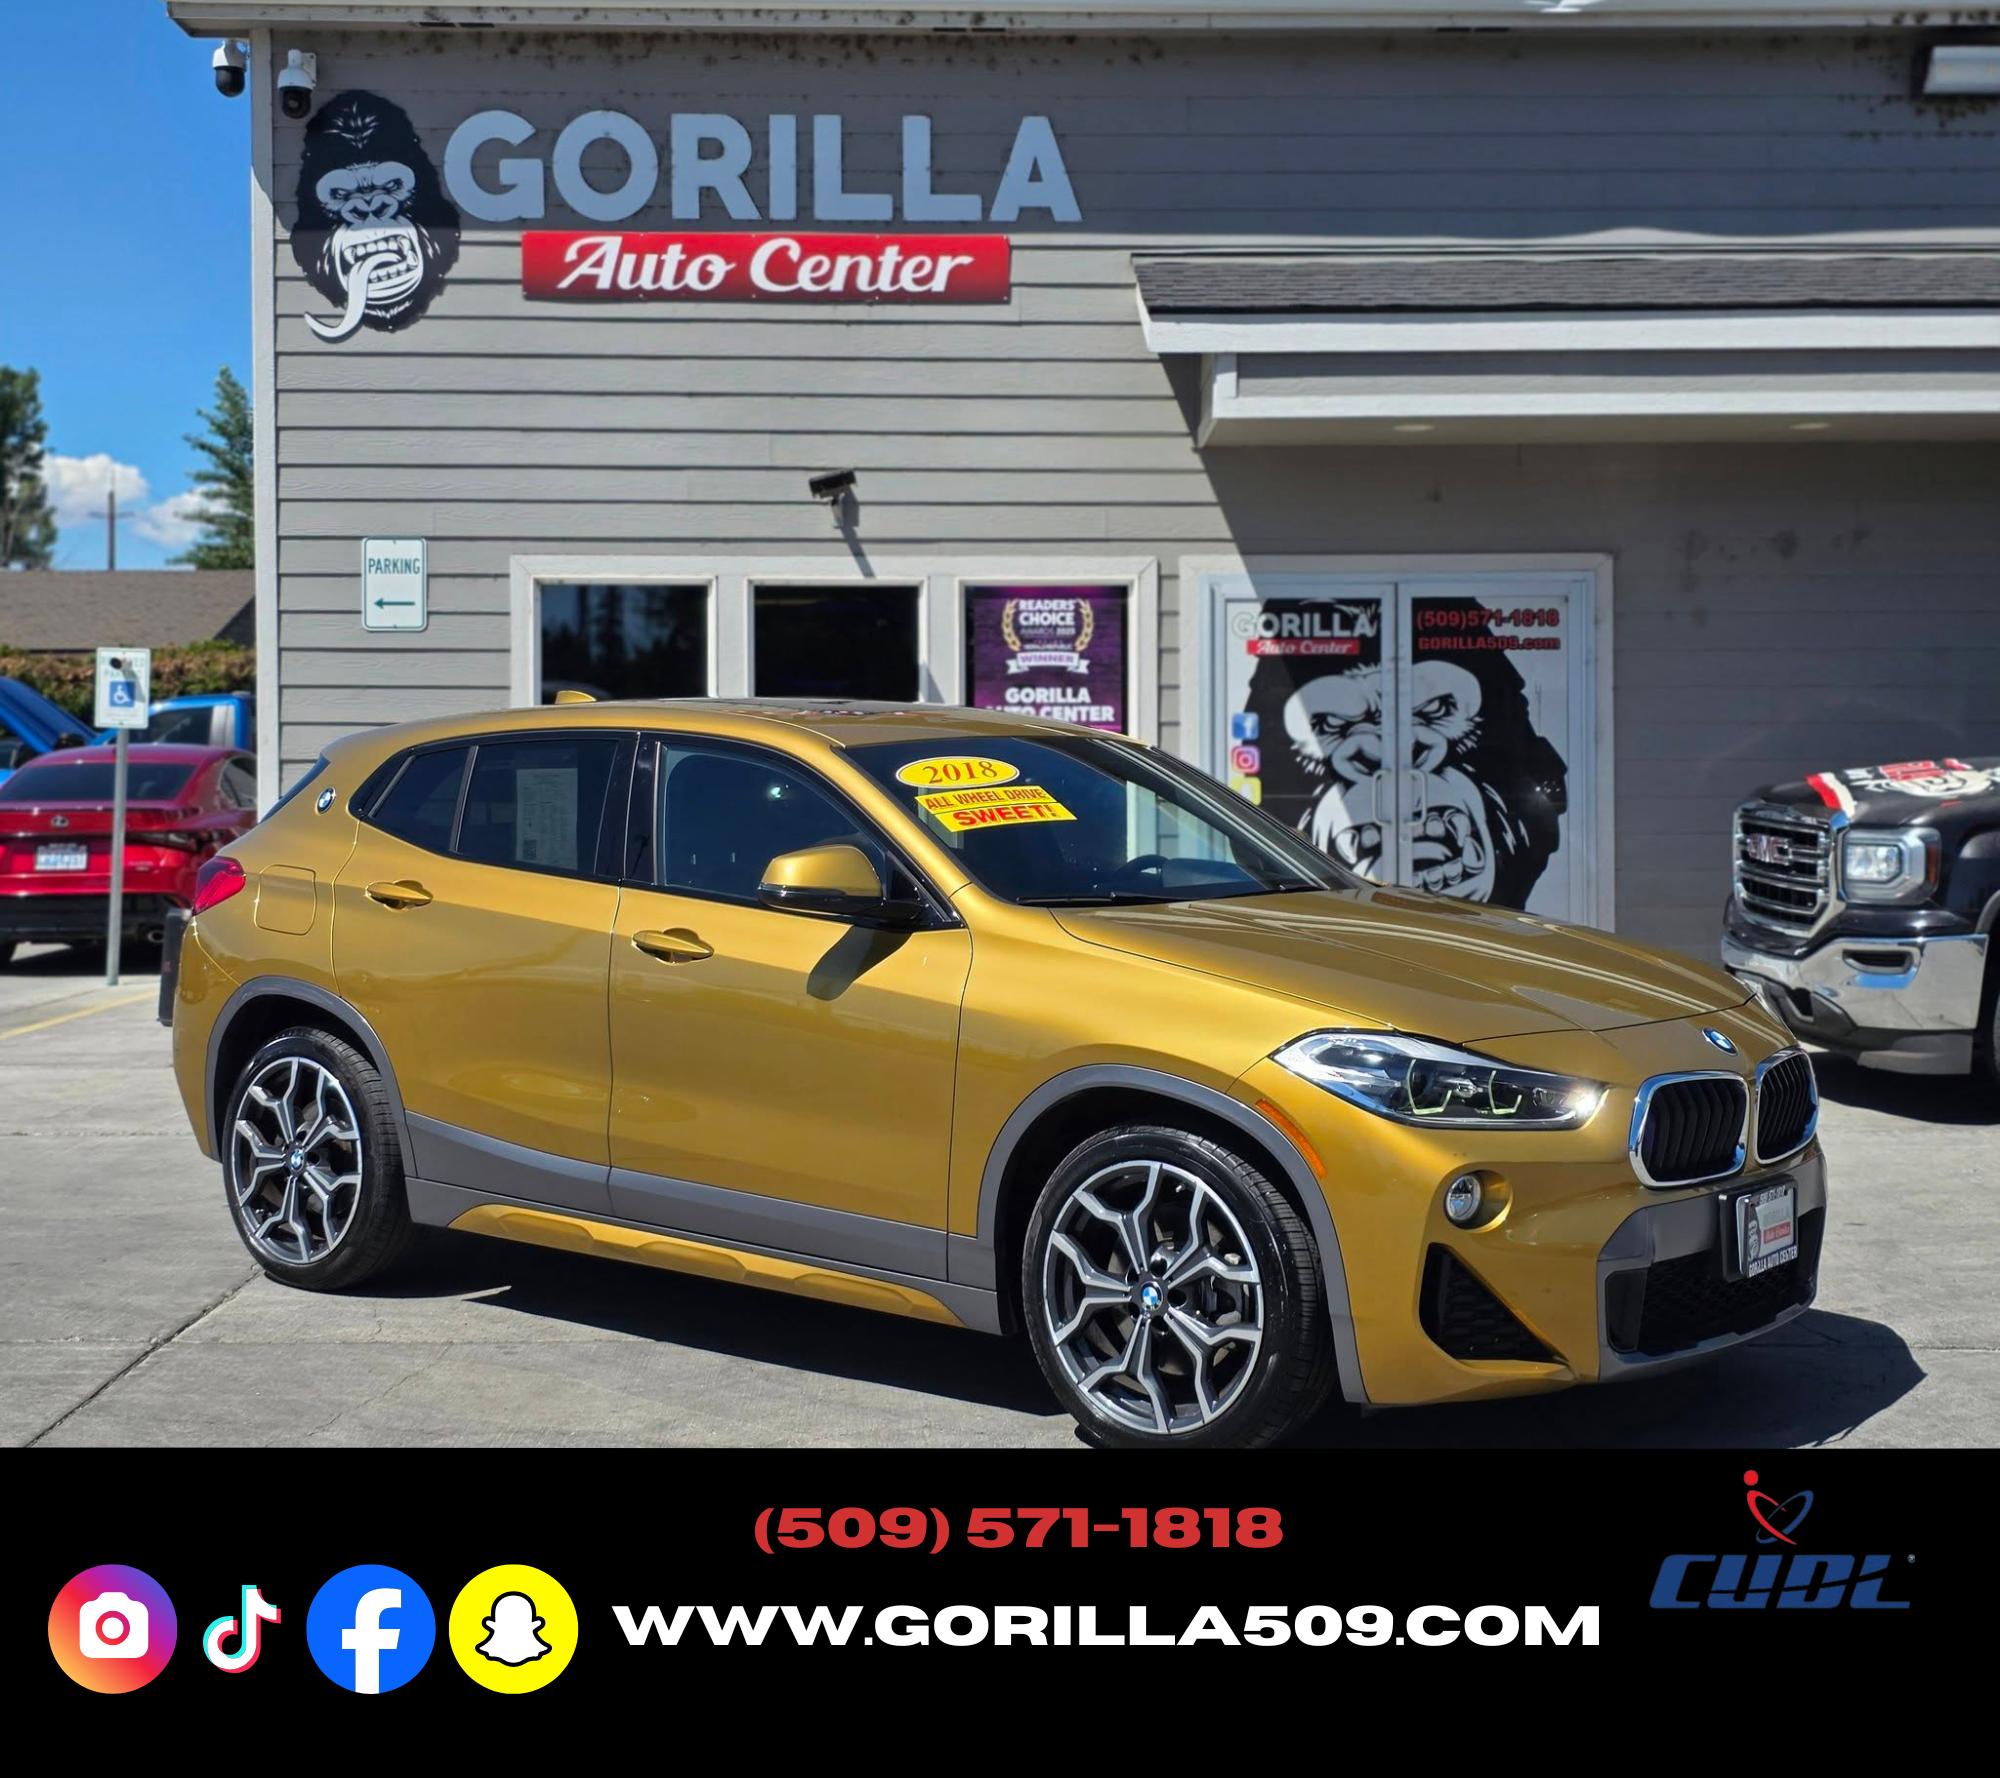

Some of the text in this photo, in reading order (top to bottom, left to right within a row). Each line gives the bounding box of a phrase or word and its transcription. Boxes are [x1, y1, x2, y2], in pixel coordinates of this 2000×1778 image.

[443, 109, 1083, 223] GORILLA
[556, 235, 974, 293] Auto Center
[367, 557, 421, 575] PARKING
[1019, 612, 1075, 626] CHOICE
[1231, 611, 1374, 638] GORILLA
[1416, 608, 1560, 631] (509)571-1818
[1020, 654, 1074, 663] WINNER
[1257, 640, 1352, 655] Auto Center
[1005, 687, 1091, 704] GORILLA
[1039, 705, 1115, 722] CENTER
[923, 760, 998, 784] 2018
[925, 787, 1048, 811] ALL WHEEL DRIVE
[952, 804, 1057, 827] SWEET!
